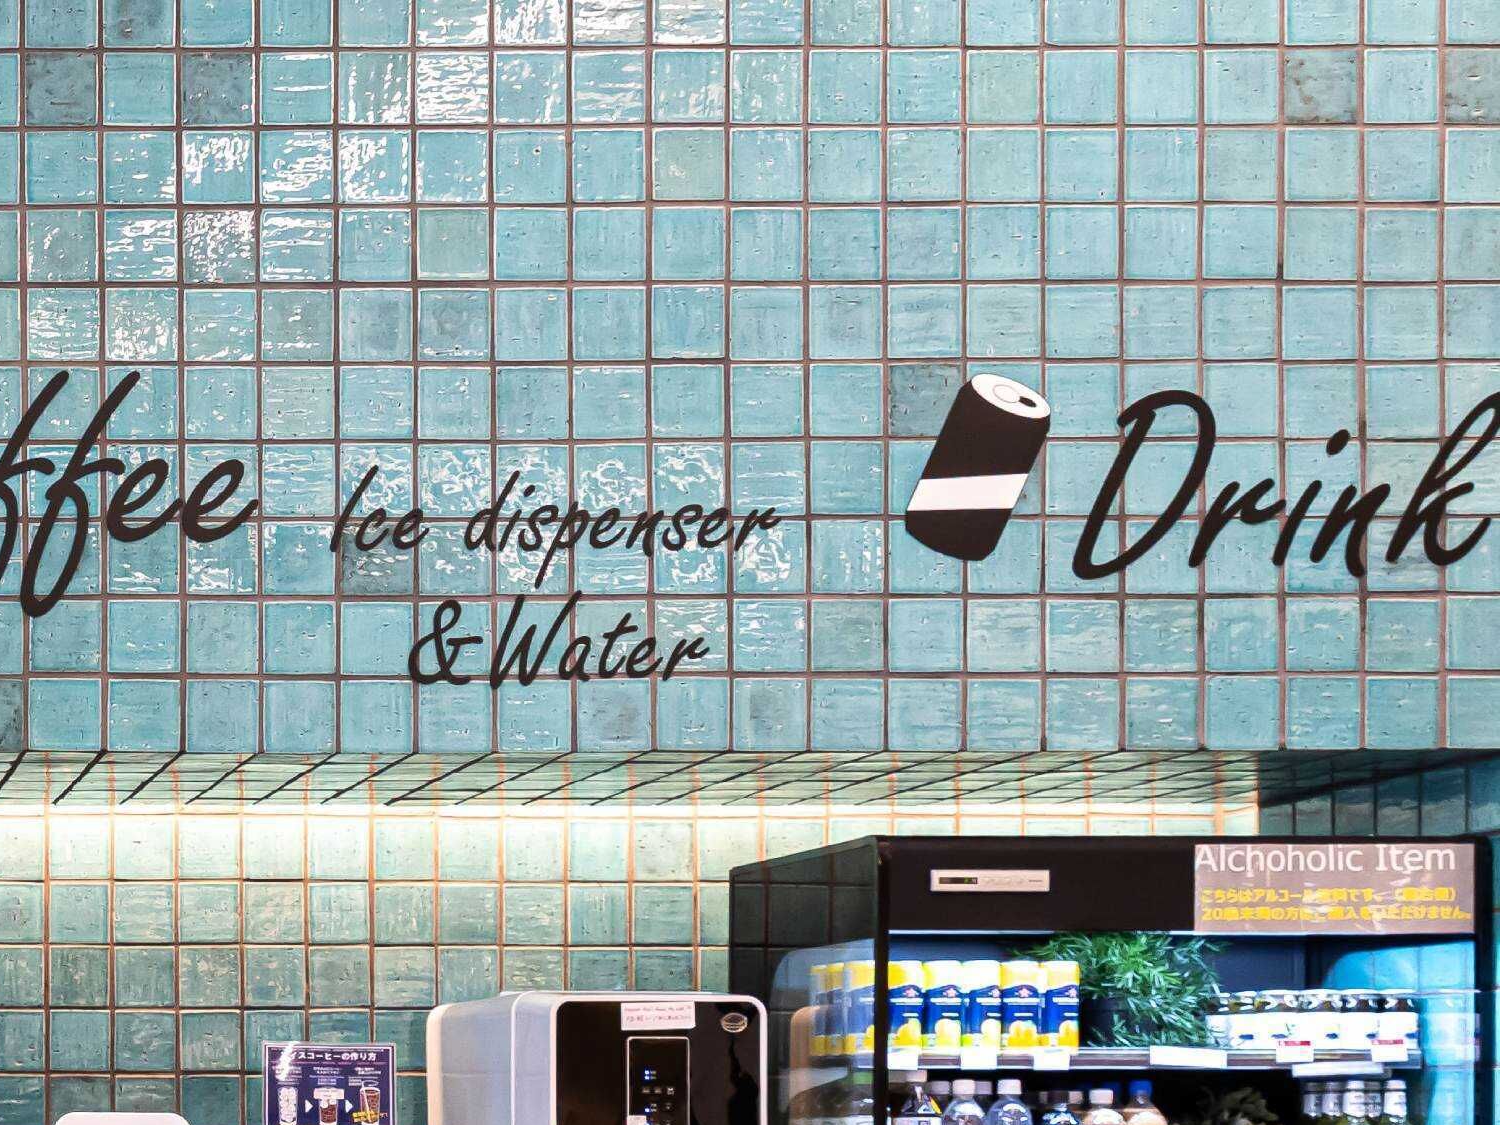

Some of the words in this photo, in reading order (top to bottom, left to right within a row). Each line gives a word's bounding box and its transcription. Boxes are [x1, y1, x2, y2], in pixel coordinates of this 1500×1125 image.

[328, 464, 430, 557] Ice
[464, 470, 784, 593] dispenser
[1071, 388, 1500, 580] Drink
[1195, 844, 1364, 872] Alchoholic
[1376, 844, 1456, 872] Item
